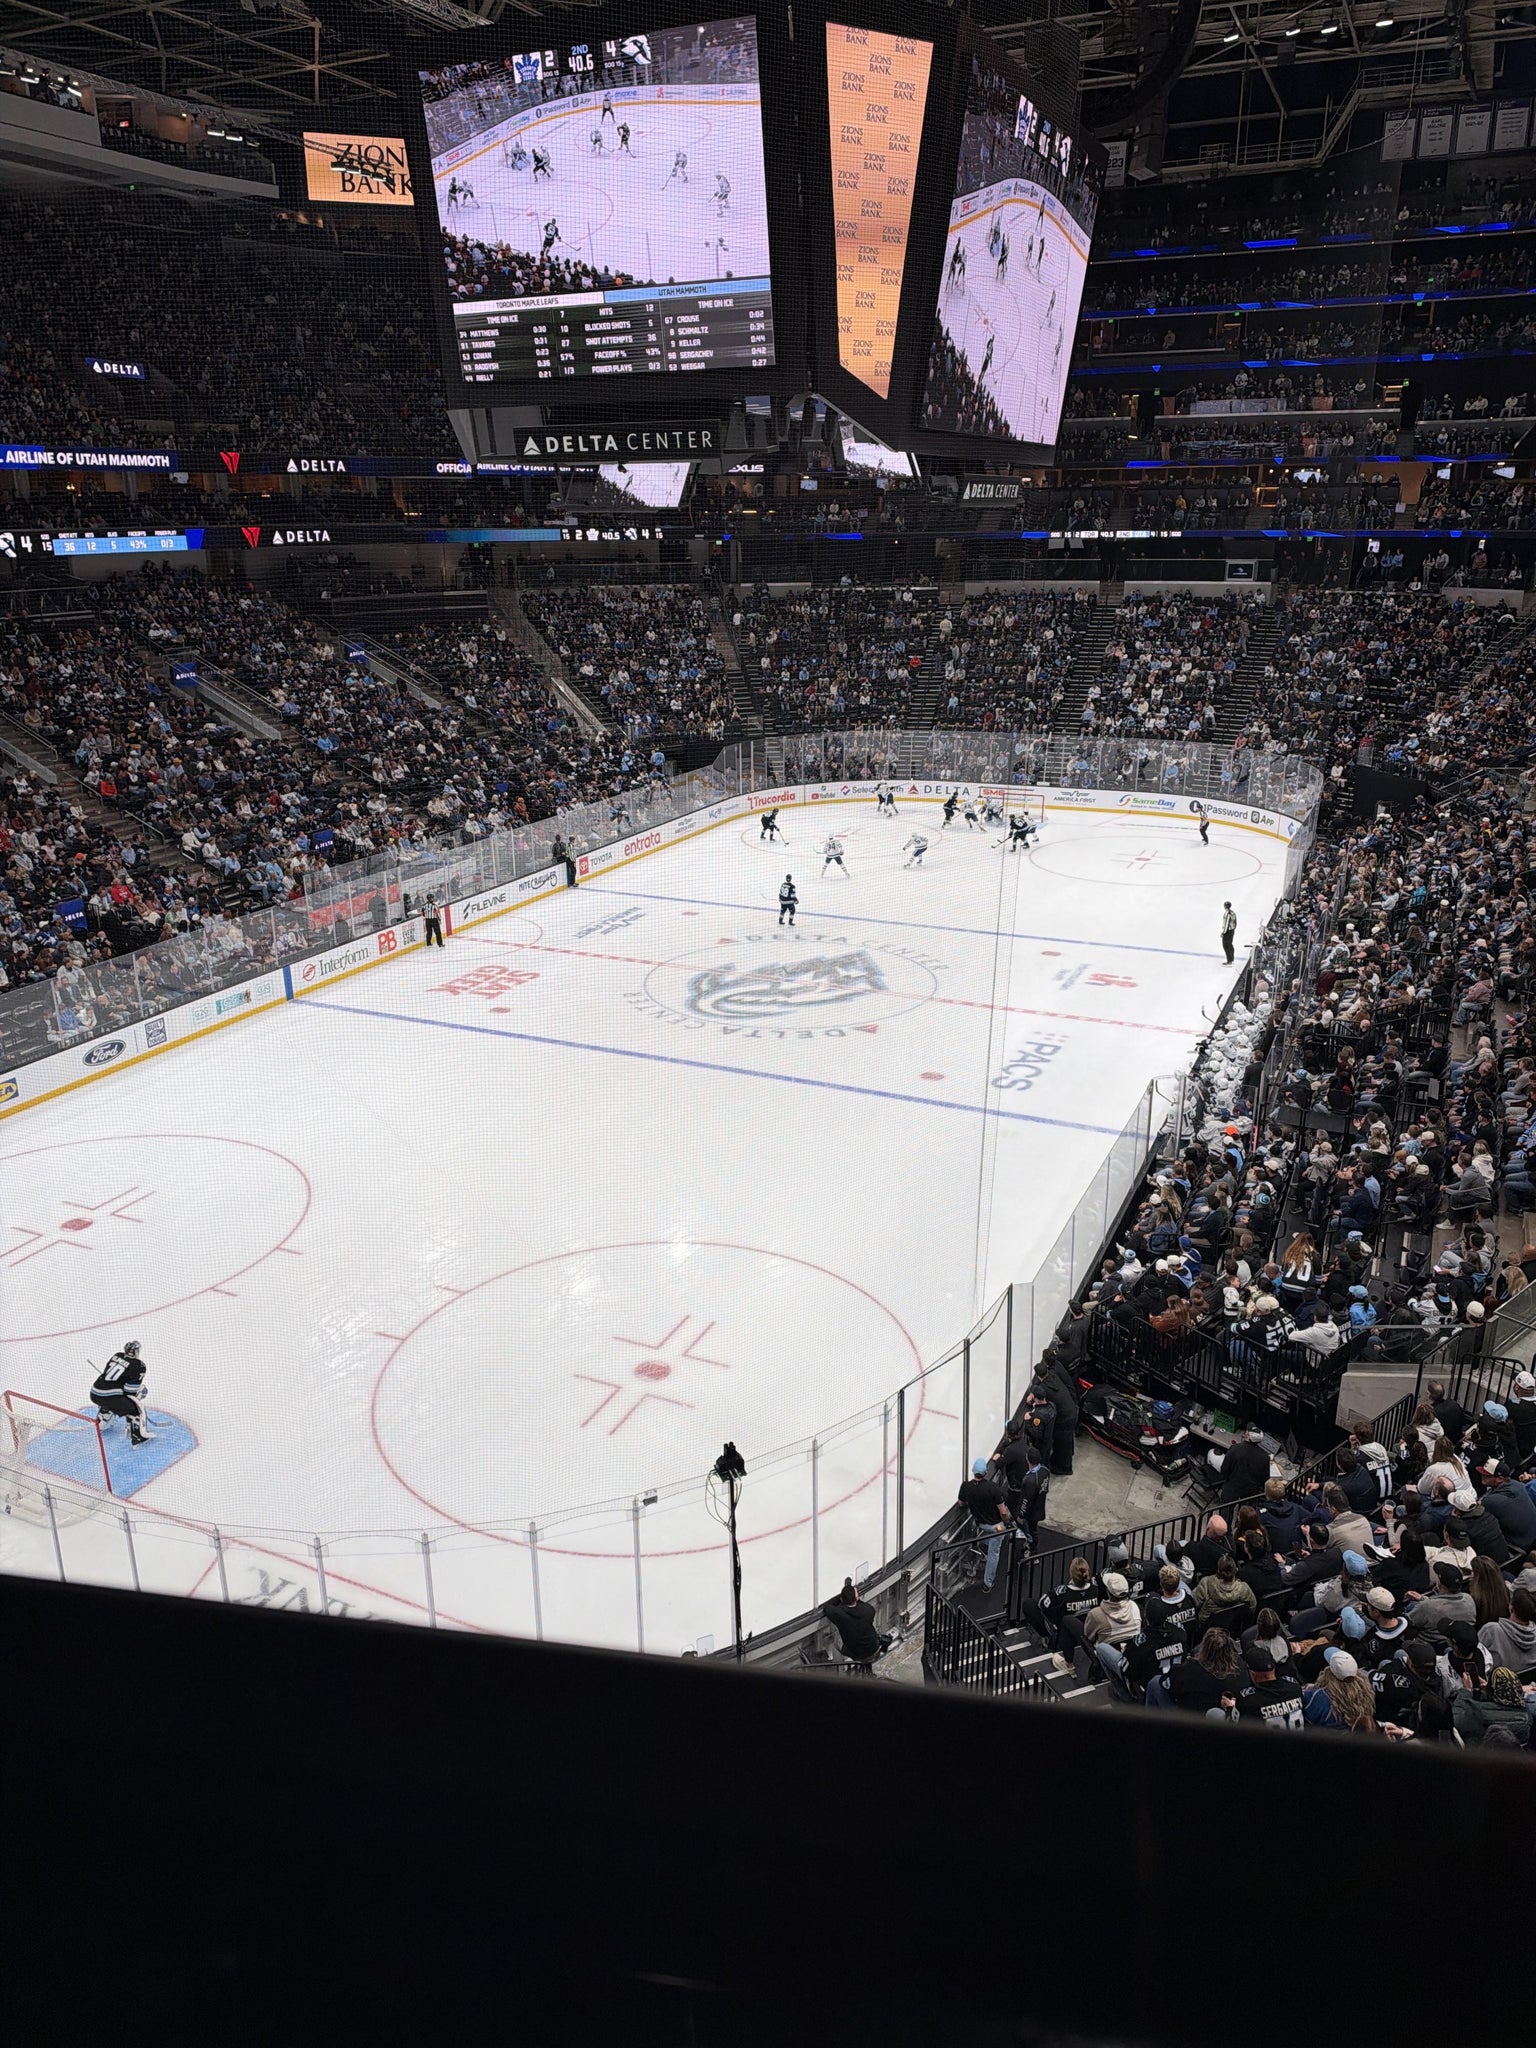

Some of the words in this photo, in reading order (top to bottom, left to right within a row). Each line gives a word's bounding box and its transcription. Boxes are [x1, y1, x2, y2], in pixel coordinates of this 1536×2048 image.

[571, 44, 588, 55] 2ND
[544, 50, 555, 67] 2
[568, 53, 594, 72] 40.6
[606, 40, 617, 57] 4
[866, 113, 887, 123] BANK
[841, 125, 863, 136] ZIONS
[841, 135, 863, 146] BANK
[889, 132, 910, 143] ZIONS
[888, 142, 910, 153] BANK
[863, 153, 886, 163] ZIONS
[863, 162, 885, 173] BANK
[838, 170, 860, 180] ZIONS
[340, 172, 413, 196] BANK
[837, 179, 859, 190] BANK
[888, 177, 909, 187] ZIONS
[887, 186, 908, 196] BANK
[861, 199, 882, 209] ZIONS
[861, 208, 881, 218] BANK
[883, 226, 903, 236] ZIONS
[882, 235, 903, 244] BANK
[859, 245, 879, 255] ZIONS
[858, 254, 879, 264] BANK
[881, 268, 901, 277] ZIONS
[881, 277, 900, 286] BANK
[659, 287, 675, 296] UTAH
[676, 285, 706, 295] MAMMOTH
[855, 291, 876, 300] ZIONS
[496, 301, 521, 309] TORONTO
[521, 299, 541, 307] MAPLE
[540, 297, 559, 306] LEAFS
[698, 300, 714, 309] TIME
[714, 299, 723, 307] ON
[723, 298, 734, 307] ICE
[855, 299, 875, 309] BANK
[599, 308, 613, 316] HITS
[645, 304, 654, 312] 12
[486, 316, 501, 325] TIME
[500, 315, 509, 324] ON
[508, 314, 519, 323] ICE
[664, 317, 673, 325] 67
[676, 315, 700, 323] CROUSE
[748, 311, 765, 319] 0:02
[560, 325, 569, 333] 10
[584, 322, 611, 332] BLOCKED
[611, 320, 631, 329] SHOTS
[677, 327, 709, 335] SCHMALTZ
[749, 323, 765, 331] 0:34
[876, 320, 896, 329] ZIONS
[469, 329, 499, 337] MATTHEWS
[876, 328, 894, 337] BANK
[471, 340, 496, 349] TAVARES
[585, 337, 601, 346] SHOT
[601, 335, 633, 344] ATTEMPTS
[647, 334, 657, 342] 36
[678, 339, 701, 347] KELLER
[853, 340, 873, 348] ZIONS
[535, 348, 549, 356] 0:23
[560, 353, 575, 361] 57%
[594, 350, 619, 359] FACEOFF
[645, 348, 661, 356] 43%
[680, 350, 714, 359] SERGACHEV
[751, 347, 767, 355] 0:42
[852, 348, 872, 357] BANK
[103, 362, 140, 376] DELTA
[563, 367, 575, 375] 1/3
[591, 366, 613, 374] POWER
[612, 364, 633, 372] PLAYS
[648, 362, 661, 370] 0/3
[681, 362, 706, 370] WEEGAR
[545, 434, 618, 453] DELTA
[626, 430, 713, 451] CENTER
[6, 451, 55, 464] AIRLINE
[56, 451, 74, 465] OF
[76, 452, 107, 466] UTAH
[109, 453, 170, 467] MAMMOTH
[300, 459, 346, 472] DELTA
[436, 463, 472, 473] OFFICIA
[971, 483, 994, 498] DELTA
[995, 484, 1019, 498] CENTER
[286, 530, 331, 543] DELTA
[575, 529, 582, 540] 2
[602, 532, 620, 540] 40.5
[641, 528, 649, 539] 4
[20, 535, 32, 552] 4
[42, 541, 53, 551] 15
[64, 542, 75, 551] 36
[86, 541, 96, 550] 12
[111, 541, 117, 550] 5
[130, 540, 147, 549] 43%
[160, 539, 174, 548] 0/3
[924, 785, 970, 796] DELTA
[983, 788, 1005, 797] SMS
[754, 792, 796, 807] Trucordia
[1132, 797, 1176, 809] SameDay
[1203, 803, 1249, 819] 1Password
[624, 832, 661, 857] entrata
[590, 852, 612, 867] TOYOTA
[471, 893, 506, 914] FILEVINE
[745, 934, 849, 944] DELTA
[860, 939, 950, 972] CENTER
[319, 947, 369, 976] Interform
[622, 990, 708, 1032] CENTER
[721, 1025, 848, 1039] DELTA
[91, 1044, 118, 1064] Ford
[991, 1041, 1063, 1092] PACS
[1376, 1465, 1393, 1498] 11
[1066, 1597, 1099, 1612] SCHMALT
[1155, 1643, 1184, 1660] GUNNER
[1260, 1697, 1304, 1719] SERGACHEV
